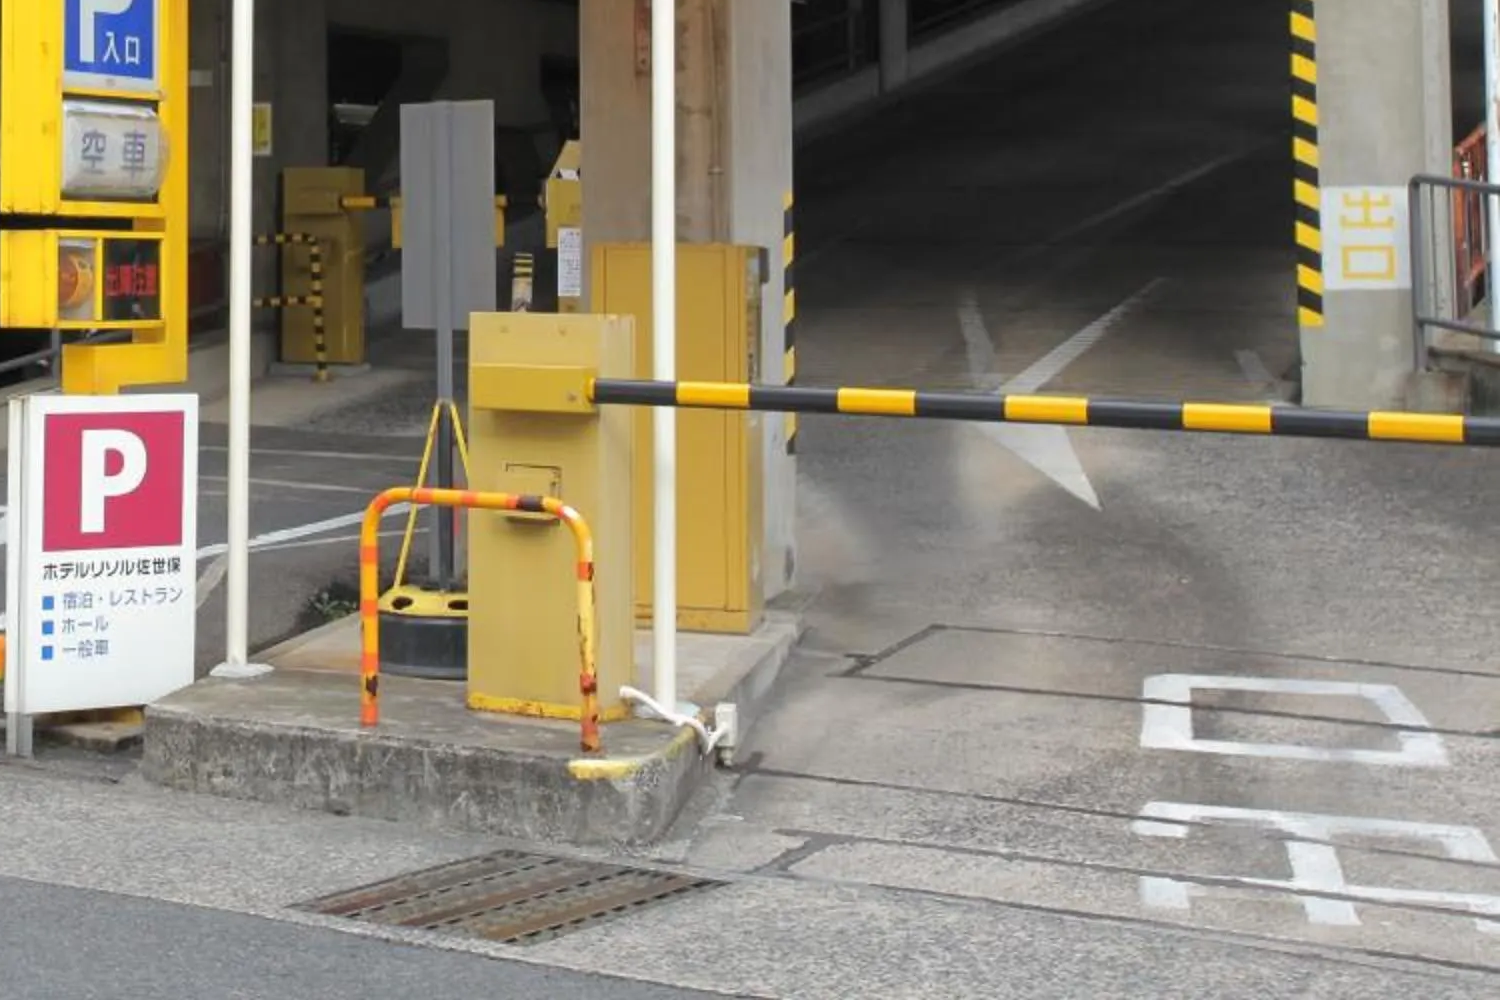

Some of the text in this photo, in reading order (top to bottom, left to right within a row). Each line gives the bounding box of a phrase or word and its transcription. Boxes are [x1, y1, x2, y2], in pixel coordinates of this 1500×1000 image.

[102, 31, 141, 65] 入口
[80, 128, 149, 176] 空車
[1340, 190, 1395, 280] 出口
[80, 429, 147, 534] P
[42, 557, 183, 581] ホテルリソル佐世保
[62, 586, 184, 610] 宿泊・レストラン
[61, 616, 109, 635] ホール
[61, 639, 109, 658] 一般車
